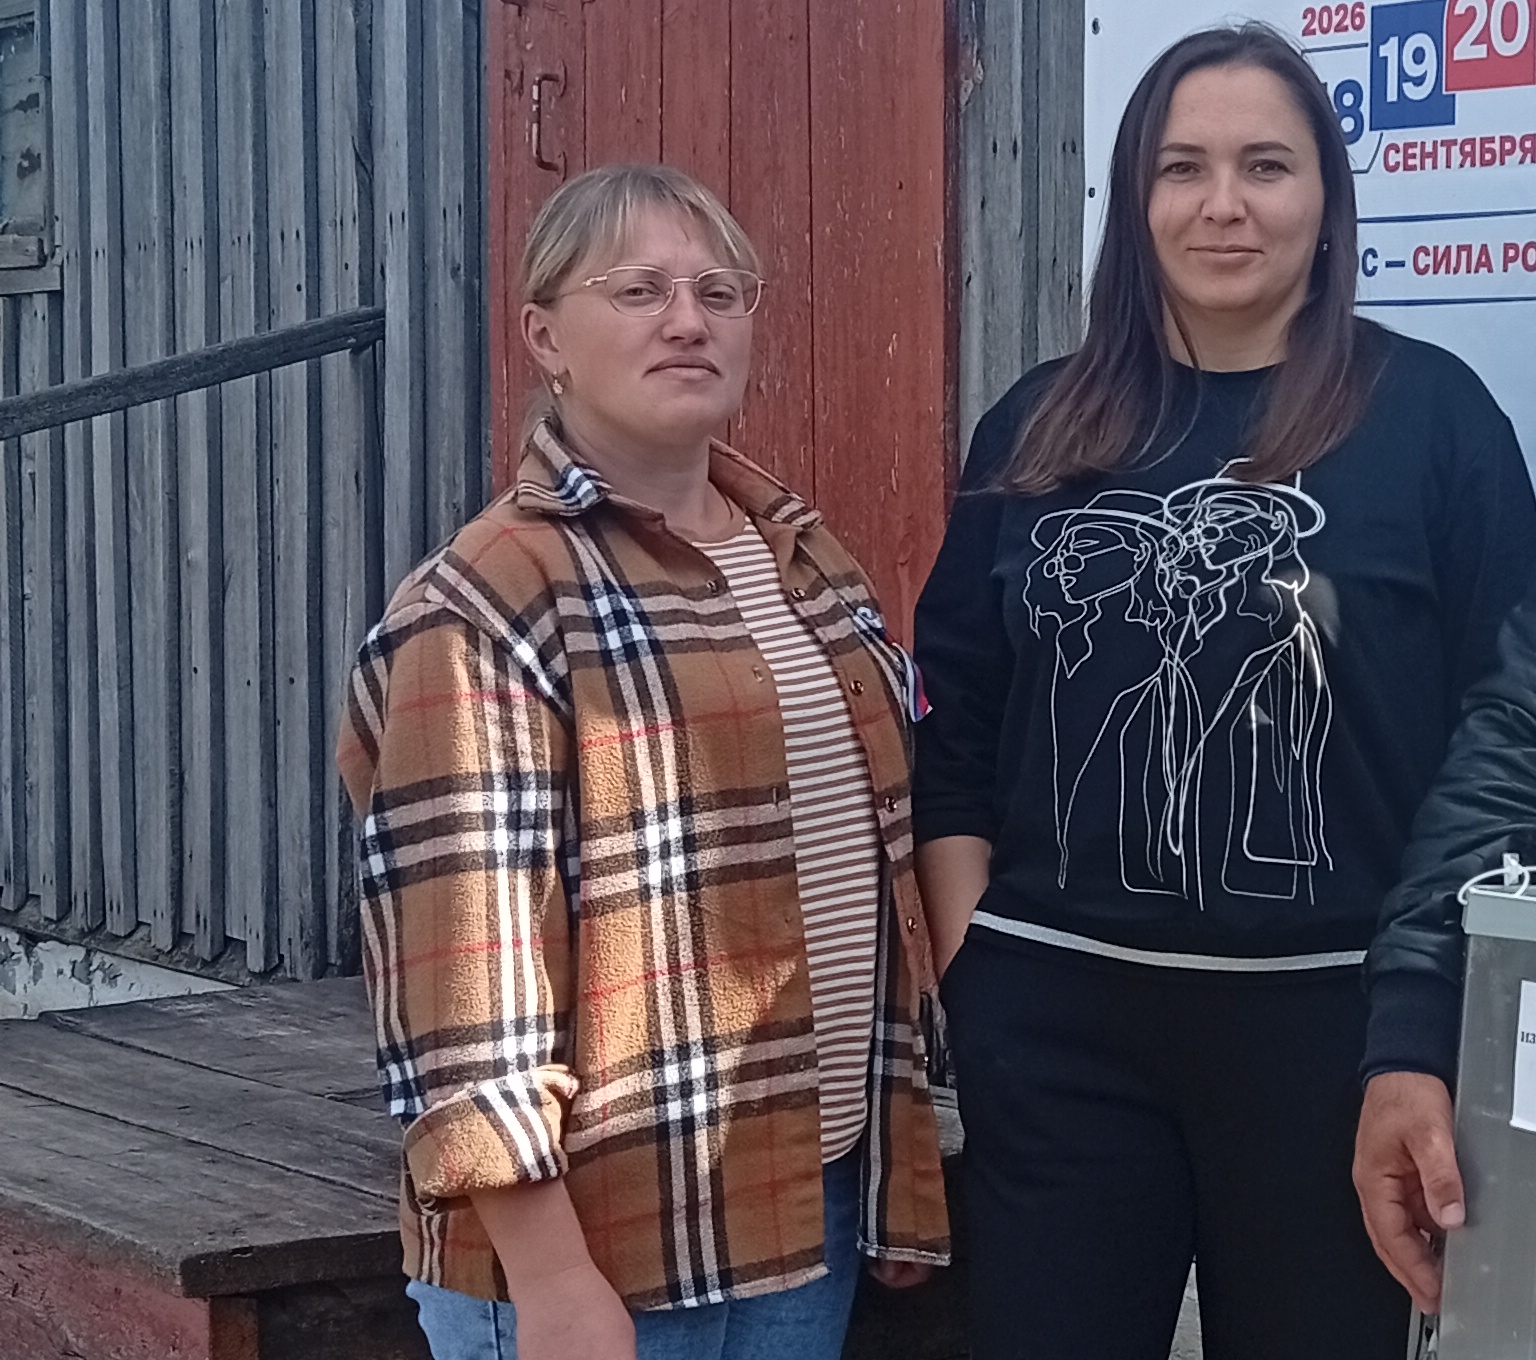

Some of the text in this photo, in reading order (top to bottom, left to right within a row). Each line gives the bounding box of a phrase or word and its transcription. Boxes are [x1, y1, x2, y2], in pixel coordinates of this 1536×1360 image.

[1301, 1, 1366, 37] 2026
[1378, 32, 1438, 104] 19
[1320, 78, 1365, 146] 8
[1412, 243, 1494, 276] СИЛА
